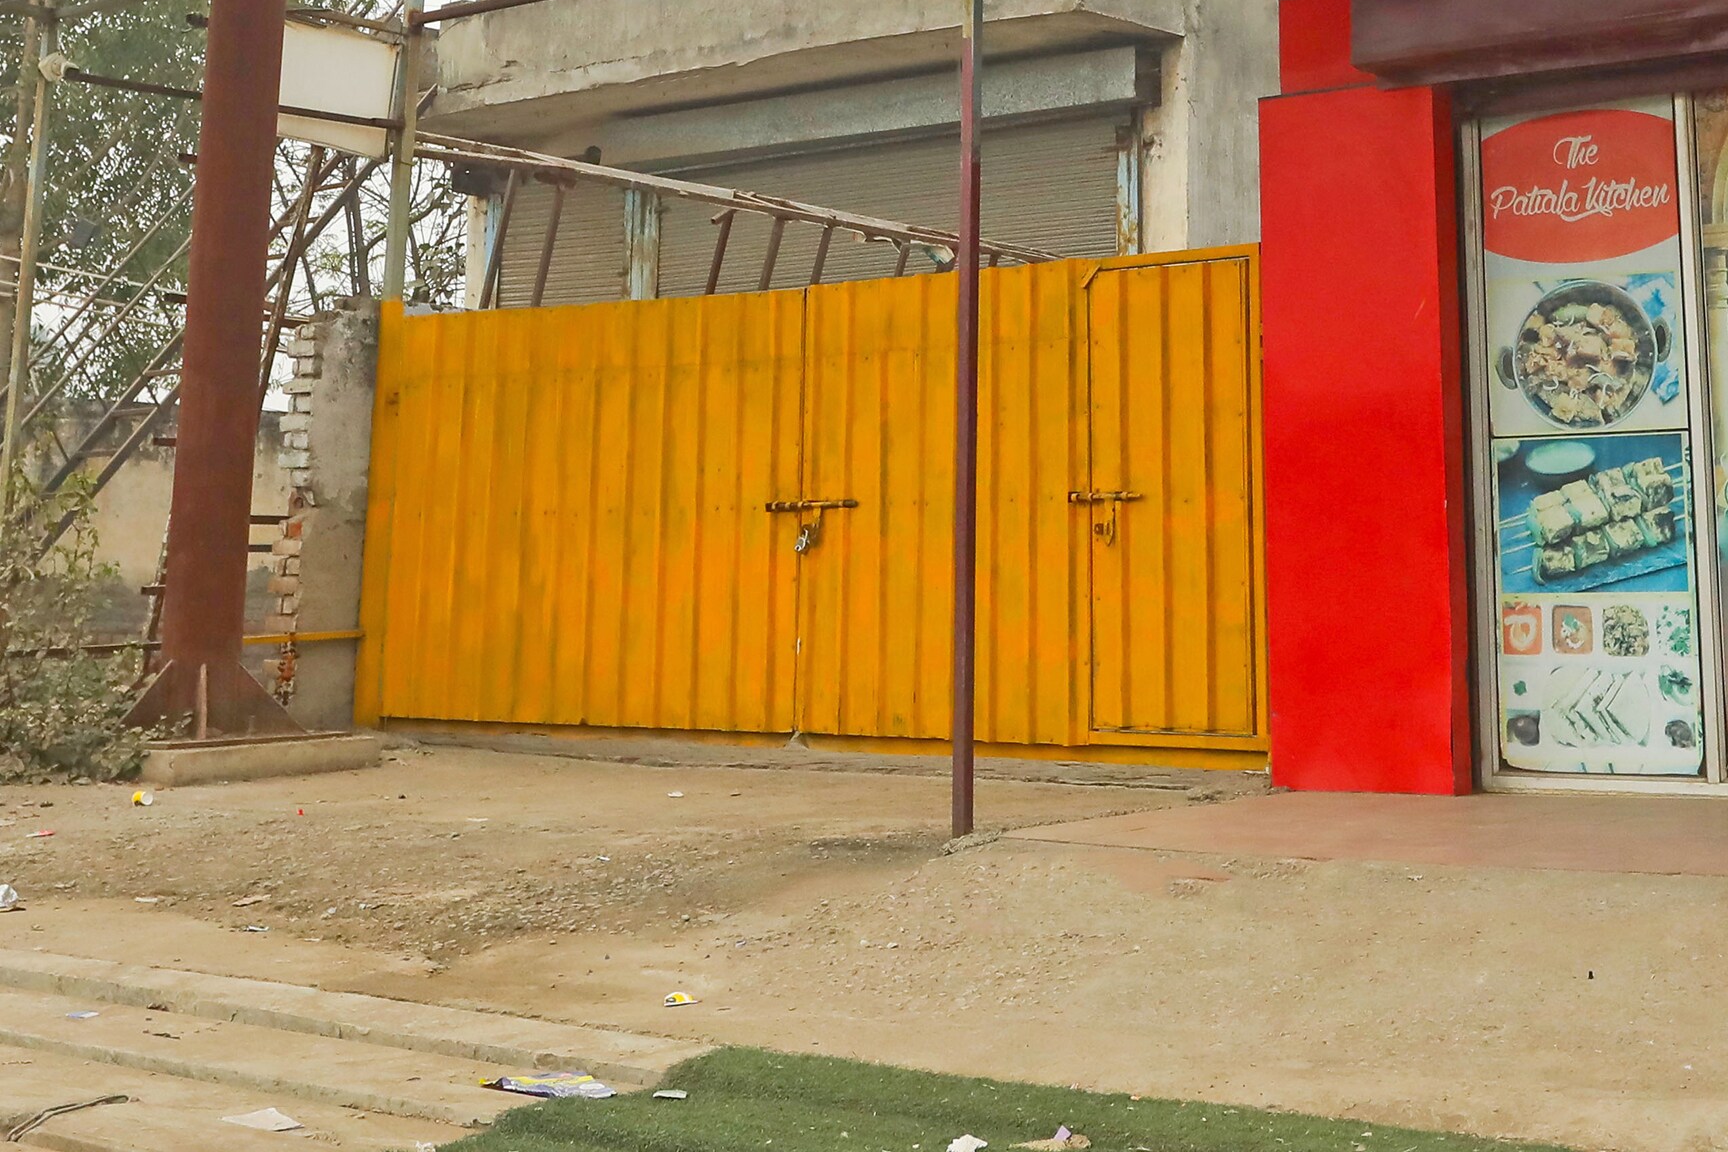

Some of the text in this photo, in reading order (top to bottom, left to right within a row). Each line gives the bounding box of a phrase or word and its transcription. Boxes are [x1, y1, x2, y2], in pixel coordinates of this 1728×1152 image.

[1553, 134, 1599, 169] The
[1490, 175, 1670, 222] Patiala Kitchen
